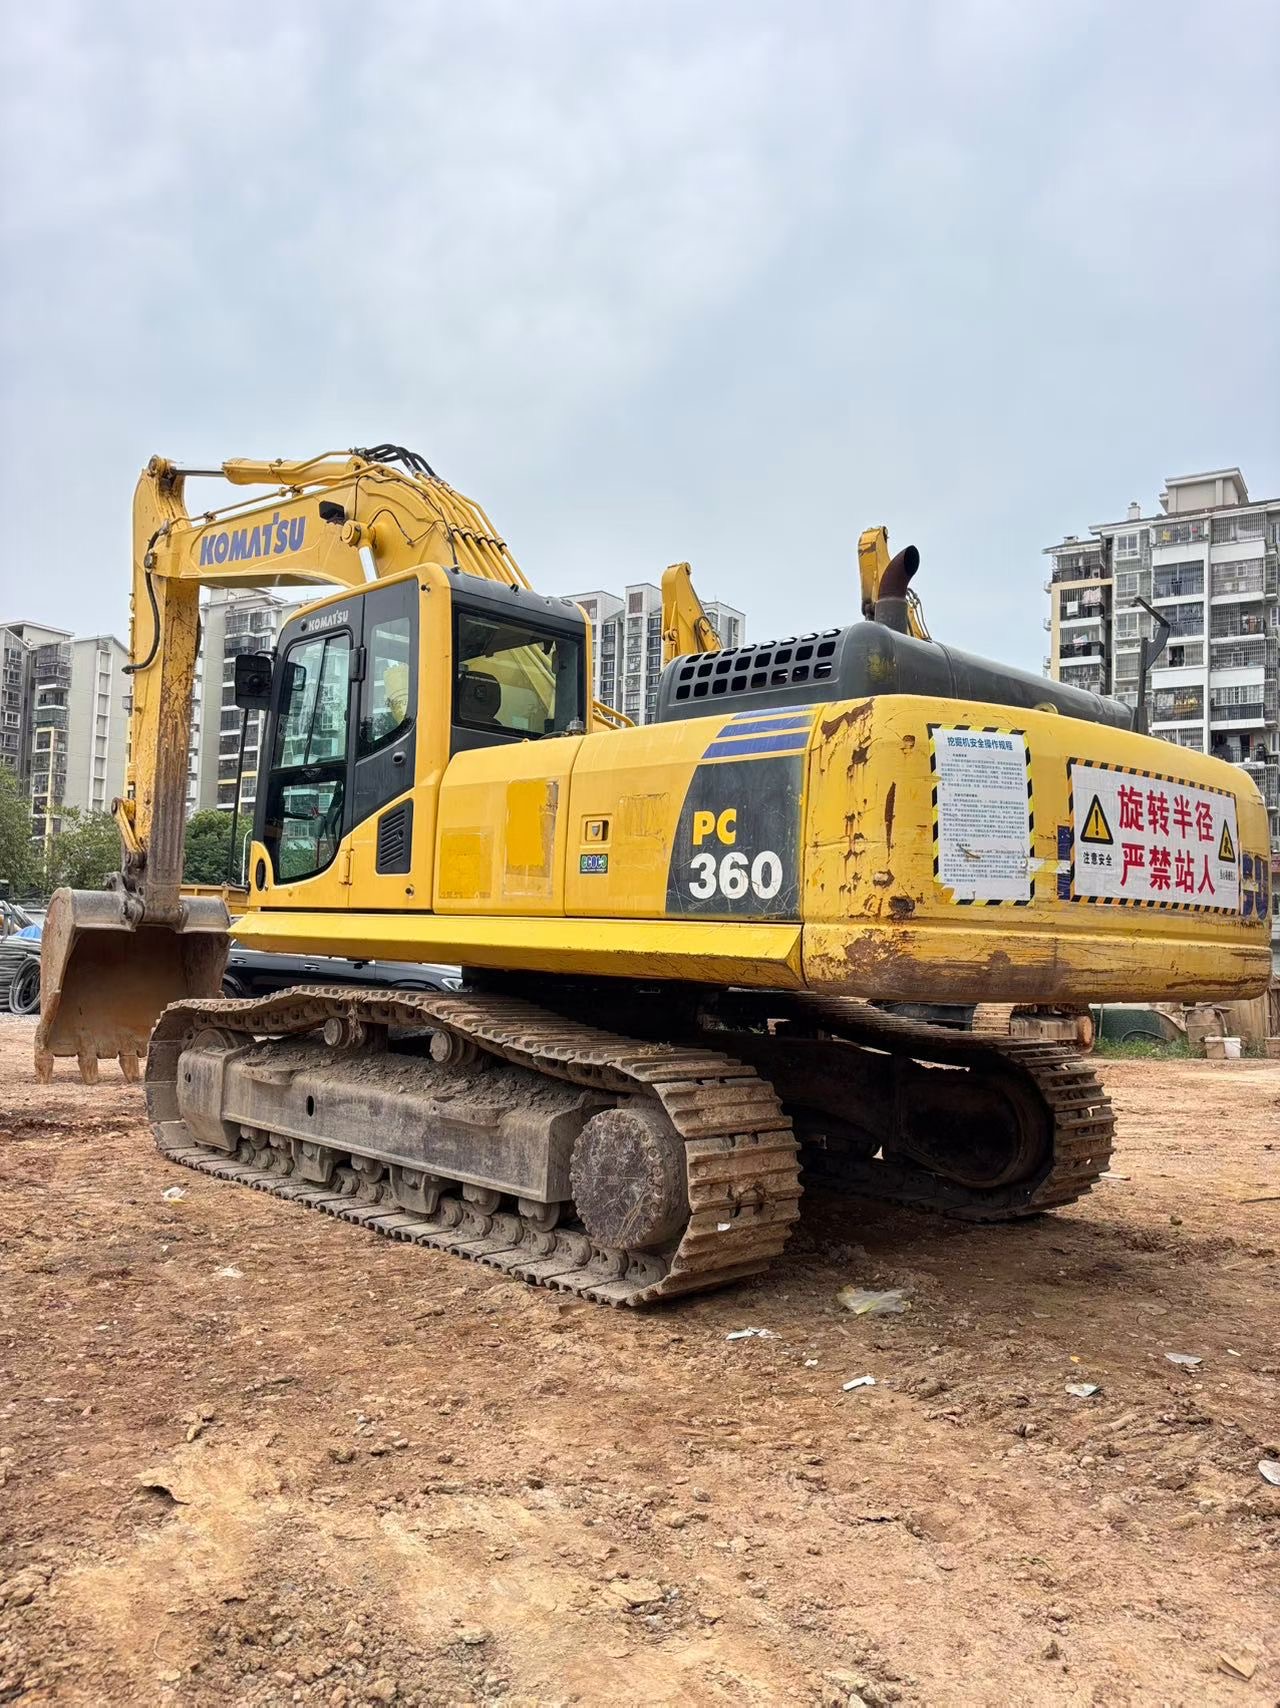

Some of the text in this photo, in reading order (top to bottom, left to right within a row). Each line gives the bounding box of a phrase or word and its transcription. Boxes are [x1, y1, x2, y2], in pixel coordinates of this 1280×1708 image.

[199, 512, 306, 566] KOMATSU
[309, 610, 349, 631] KOMATSU
[693, 808, 737, 845] PC
[1117, 784, 1215, 842] 旋转半径
[688, 850, 783, 899] 360
[1083, 851, 1112, 866] 注意安全
[1120, 842, 1216, 895] 严禁站人
